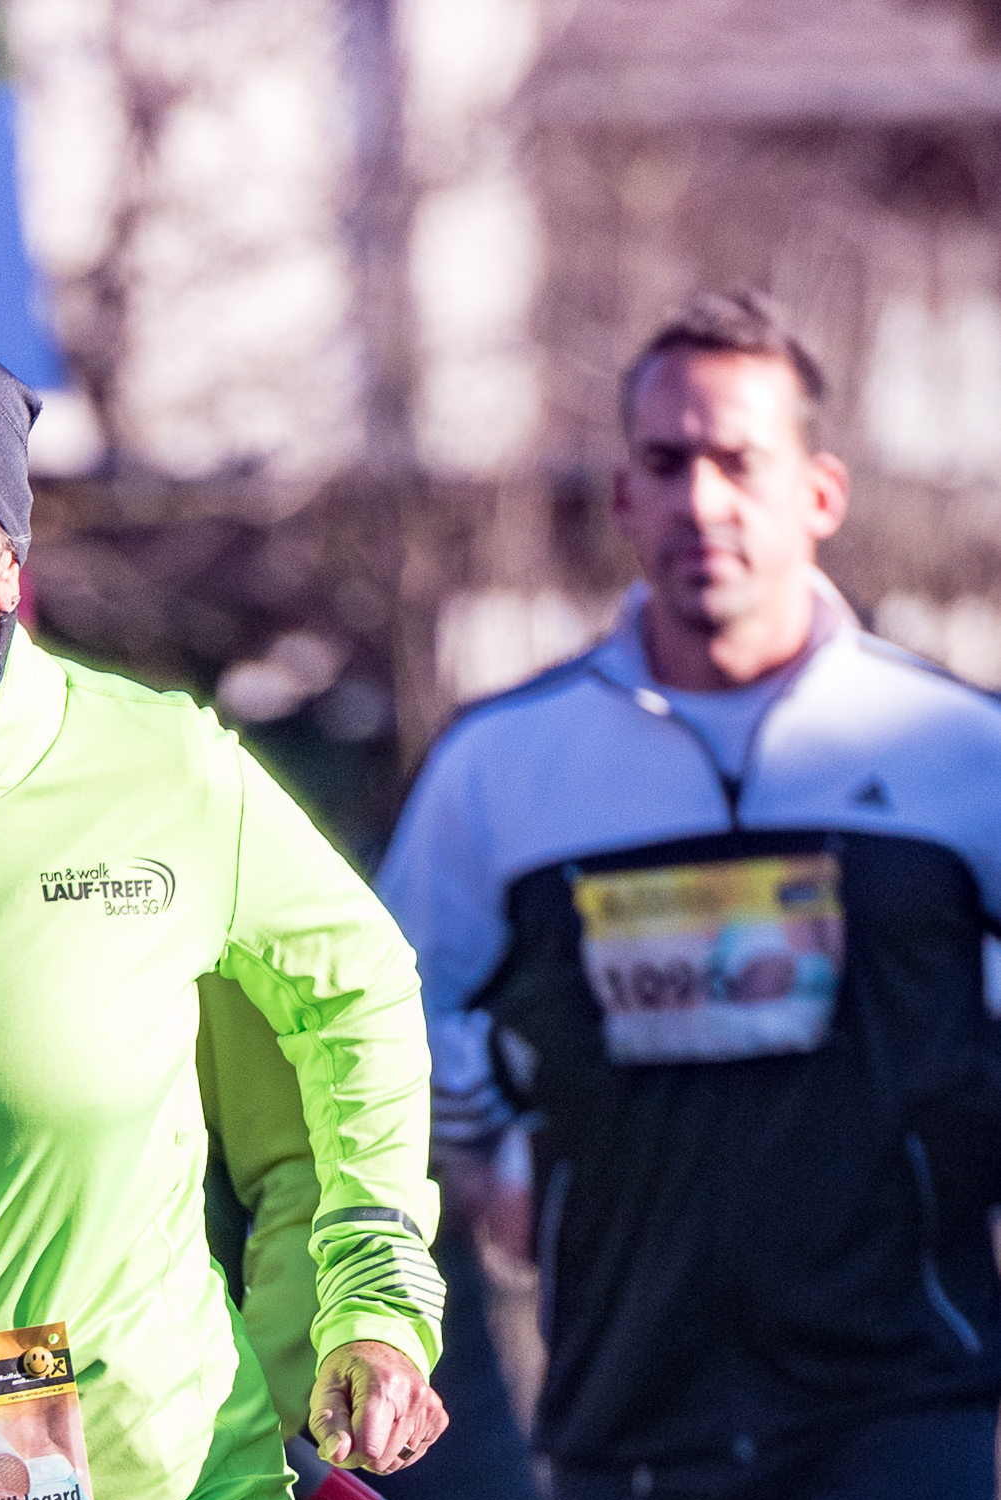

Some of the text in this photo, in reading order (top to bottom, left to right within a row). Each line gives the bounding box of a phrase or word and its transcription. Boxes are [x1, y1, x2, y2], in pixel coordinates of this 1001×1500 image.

[40, 862, 110, 883] run & walk
[42, 880, 153, 902] LAUF-TREFF
[104, 899, 159, 916] Buchs SG
